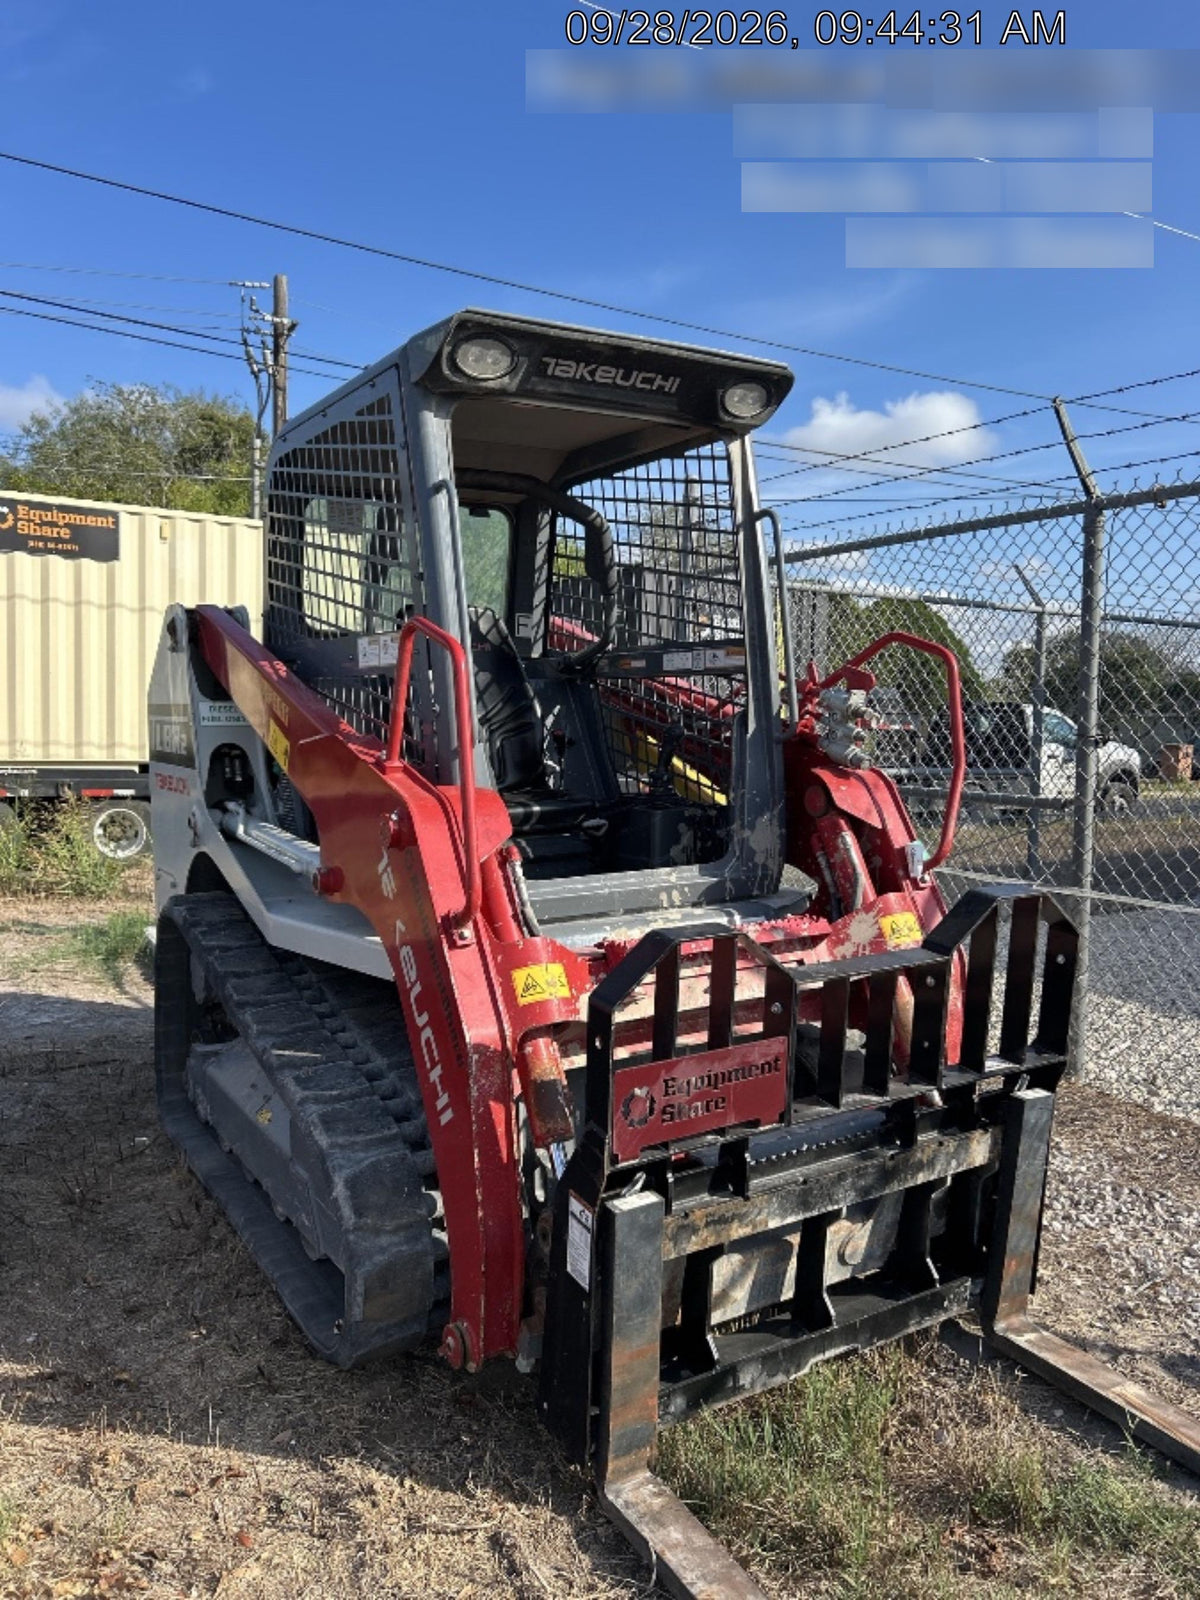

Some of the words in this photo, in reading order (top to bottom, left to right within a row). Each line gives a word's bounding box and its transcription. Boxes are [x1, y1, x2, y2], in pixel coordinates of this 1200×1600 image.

[541, 355, 681, 394] TAKEUCHI
[16, 504, 116, 529] Equipment
[16, 520, 71, 539] Share
[662, 1056, 782, 1098] Equipment
[661, 1094, 727, 1124] Share
